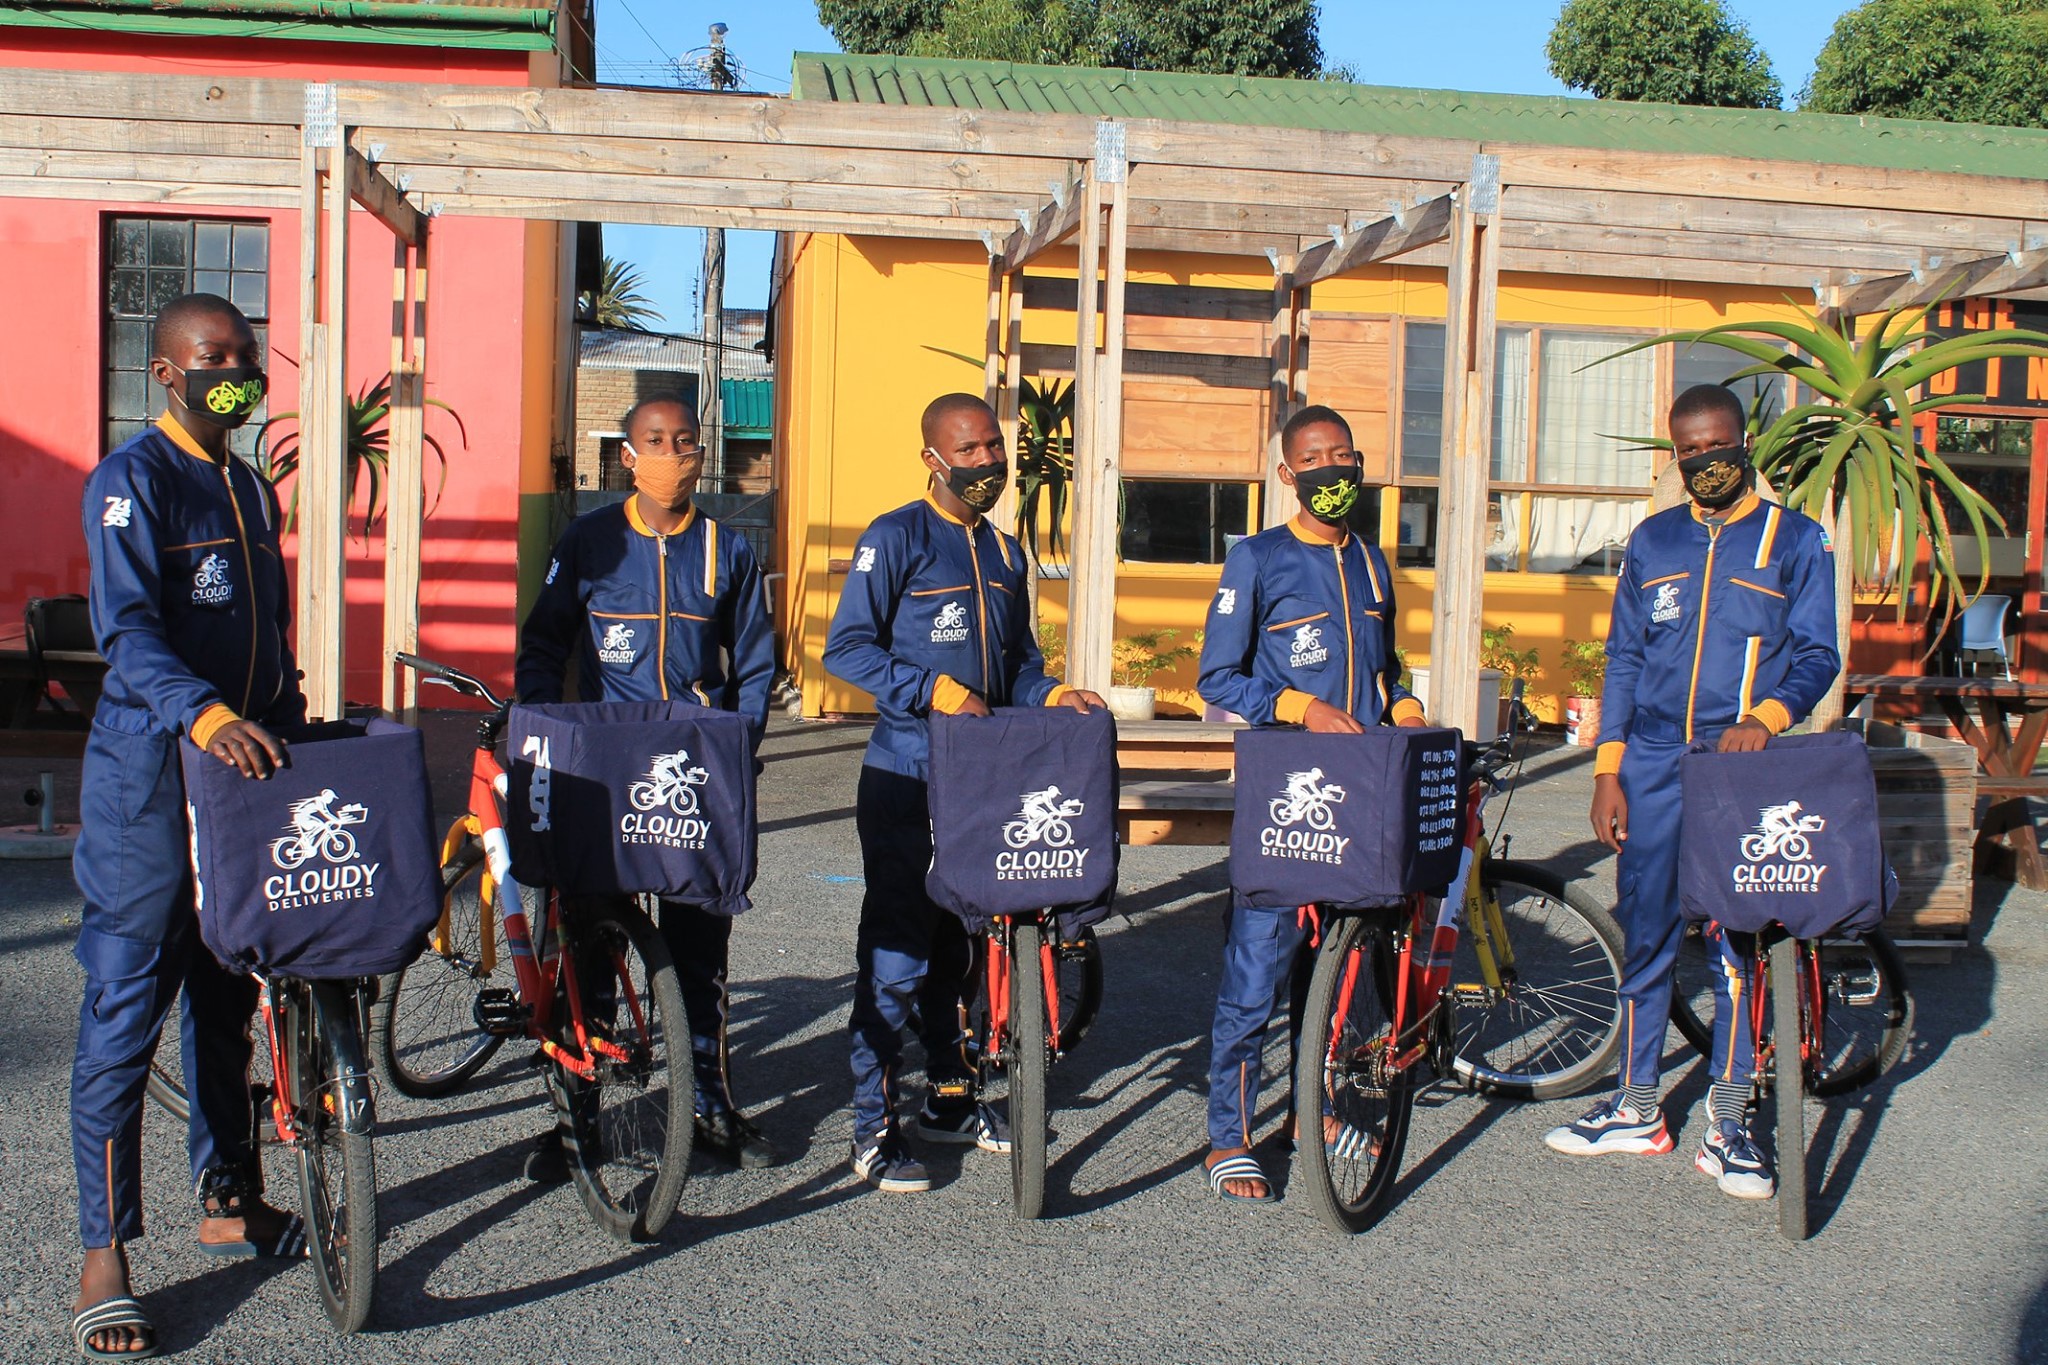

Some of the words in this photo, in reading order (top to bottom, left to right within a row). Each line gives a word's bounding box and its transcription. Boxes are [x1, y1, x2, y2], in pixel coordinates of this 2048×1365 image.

[192, 584, 233, 600] CLOUDY
[1651, 605, 1680, 620] CLOUDY
[930, 628, 969, 639] CLOUDY
[598, 649, 637, 661] CLOUDY
[1290, 647, 1328, 664] CLOUDY
[620, 813, 711, 840] CLOUDY
[622, 834, 705, 850] DELIVERIES
[1260, 827, 1350, 855] CLOUDY
[995, 848, 1089, 870] CLOUDY
[1262, 846, 1342, 865] DELIVERIES
[264, 862, 380, 900] CLOUDY
[997, 868, 1083, 880] DELIVERIES
[1733, 864, 1827, 884] CLOUDY
[1735, 883, 1819, 893] DELIVERIES
[269, 886, 375, 911] DELIVERIES
